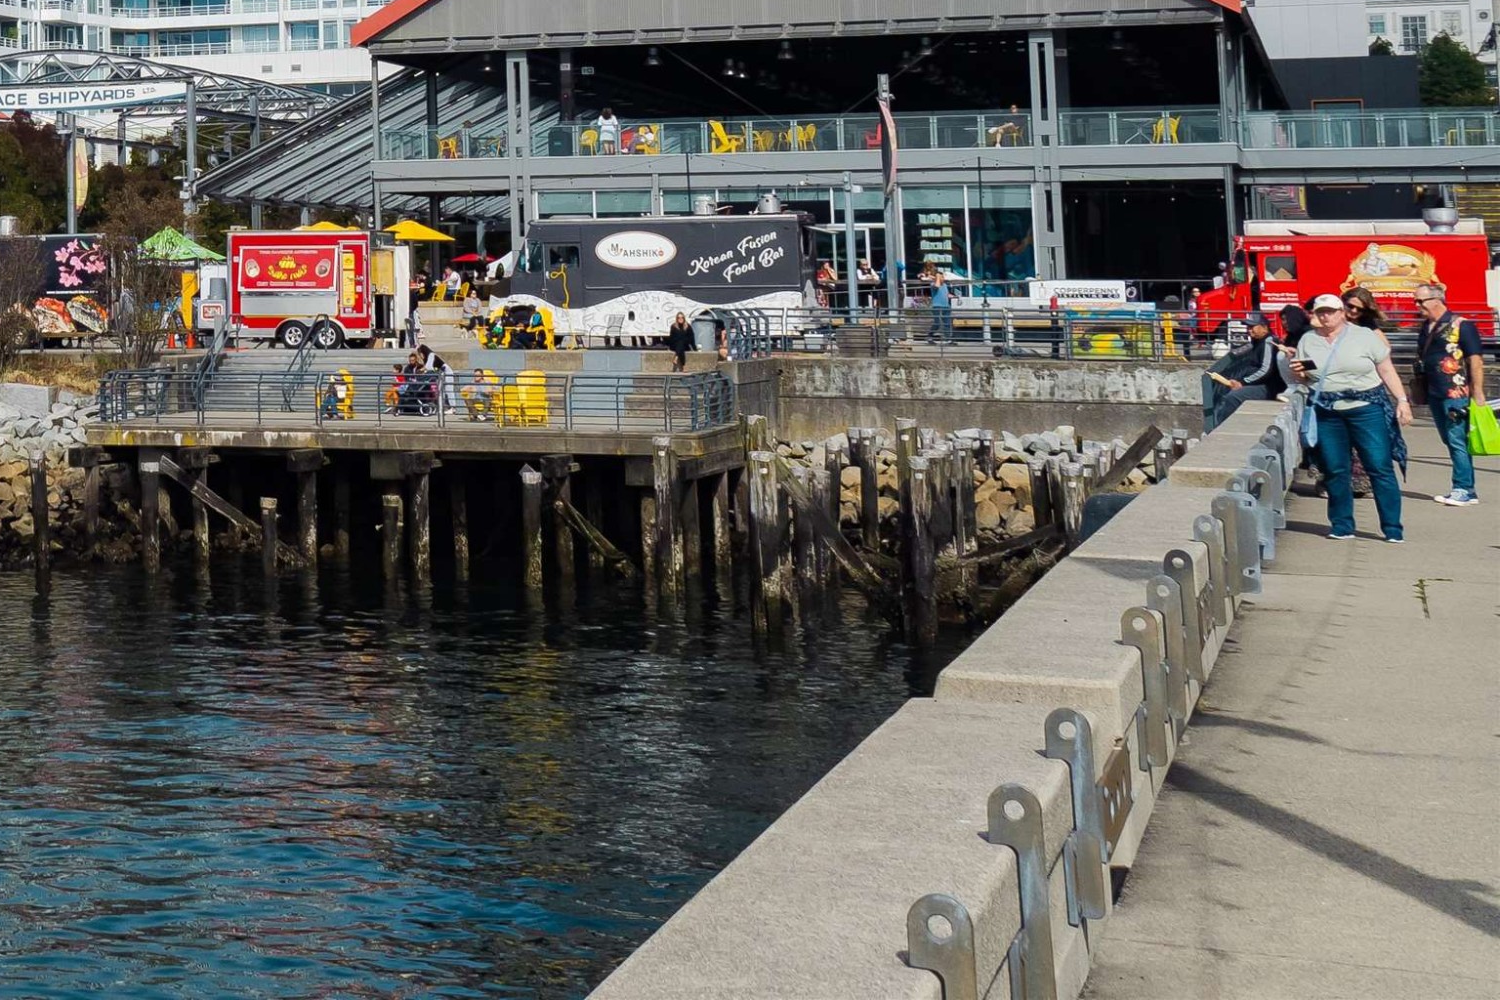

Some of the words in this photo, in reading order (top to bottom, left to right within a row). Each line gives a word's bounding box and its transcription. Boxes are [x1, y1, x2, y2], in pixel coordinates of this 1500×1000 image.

[38, 88, 136, 105] SHIPYARDS
[687, 249, 734, 276] Korean
[736, 231, 777, 256] Fusion
[723, 257, 756, 283] Food
[758, 246, 785, 268] Bar
